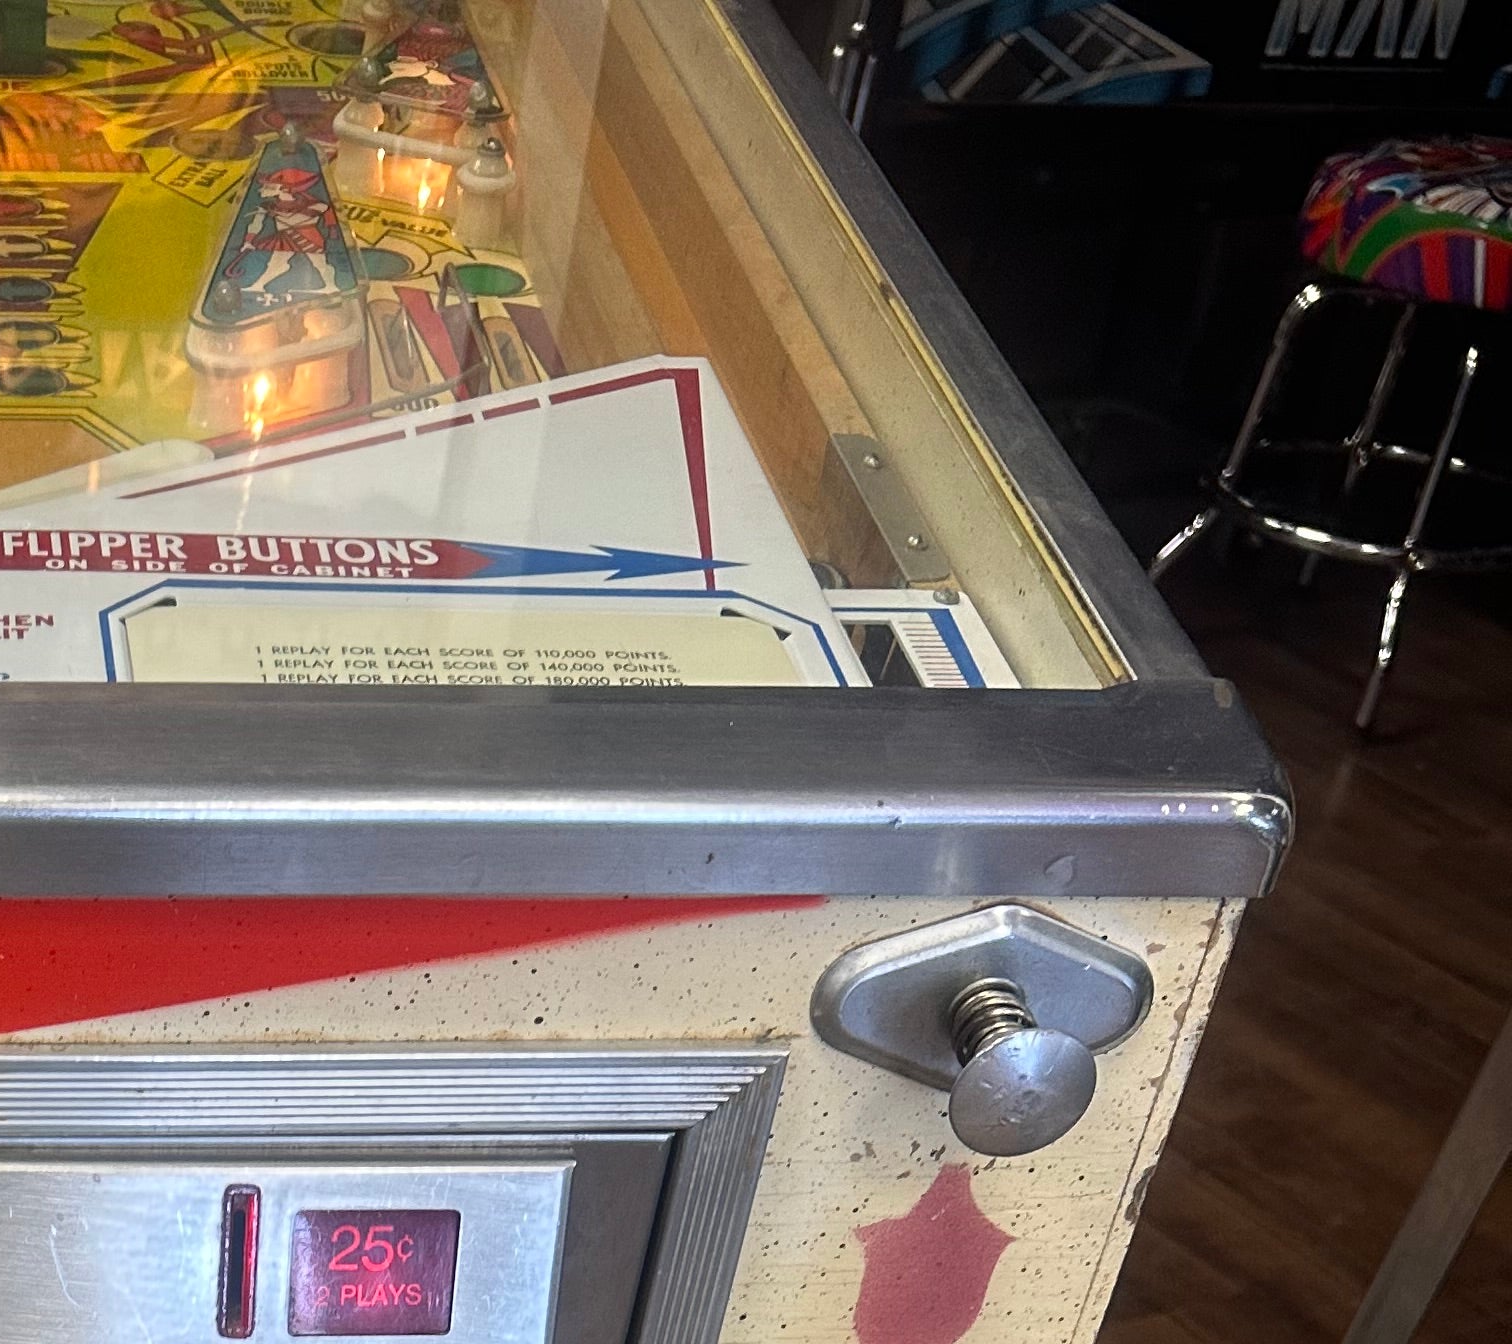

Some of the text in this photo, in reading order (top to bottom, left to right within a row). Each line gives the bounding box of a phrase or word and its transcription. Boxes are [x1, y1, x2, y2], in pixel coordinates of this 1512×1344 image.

[1, 532, 440, 566] FLIPPER BUTTONS
[45, 559, 414, 578] ON SIDE OF CABINET
[256, 646, 672, 659] 1 REPLAY FOR EACH SCORE OF 110,000 POINTS.
[259, 660, 681, 672] 1 REPLAY FOR EACH SCORE OF 140,000 POINTS.
[262, 674, 267, 683] 1
[278, 674, 338, 683] REPLAY
[349, 675, 383, 684] FOR
[391, 675, 438, 684] EACH
[448, 676, 502, 685] SCORE
[512, 676, 534, 685] OF
[328, 1225, 414, 1271] 25¢
[315, 1283, 422, 1306] 2 PLAYS
